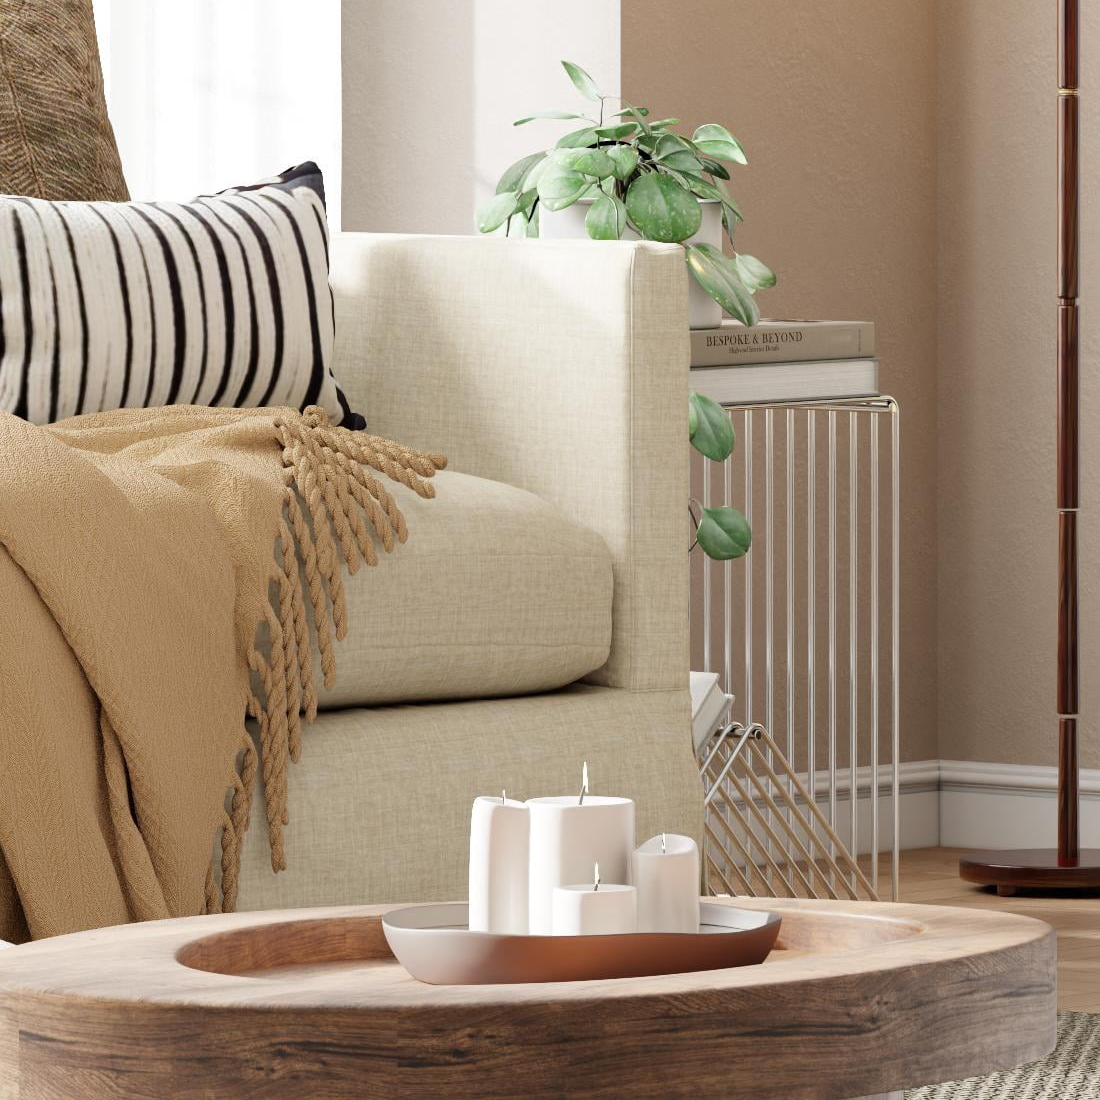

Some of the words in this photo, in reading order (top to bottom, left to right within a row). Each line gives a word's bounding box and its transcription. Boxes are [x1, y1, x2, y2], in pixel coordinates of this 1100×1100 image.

[706, 333, 749, 347] BESPOKE
[752, 334, 759, 344] &
[762, 331, 803, 344] BEYOND
